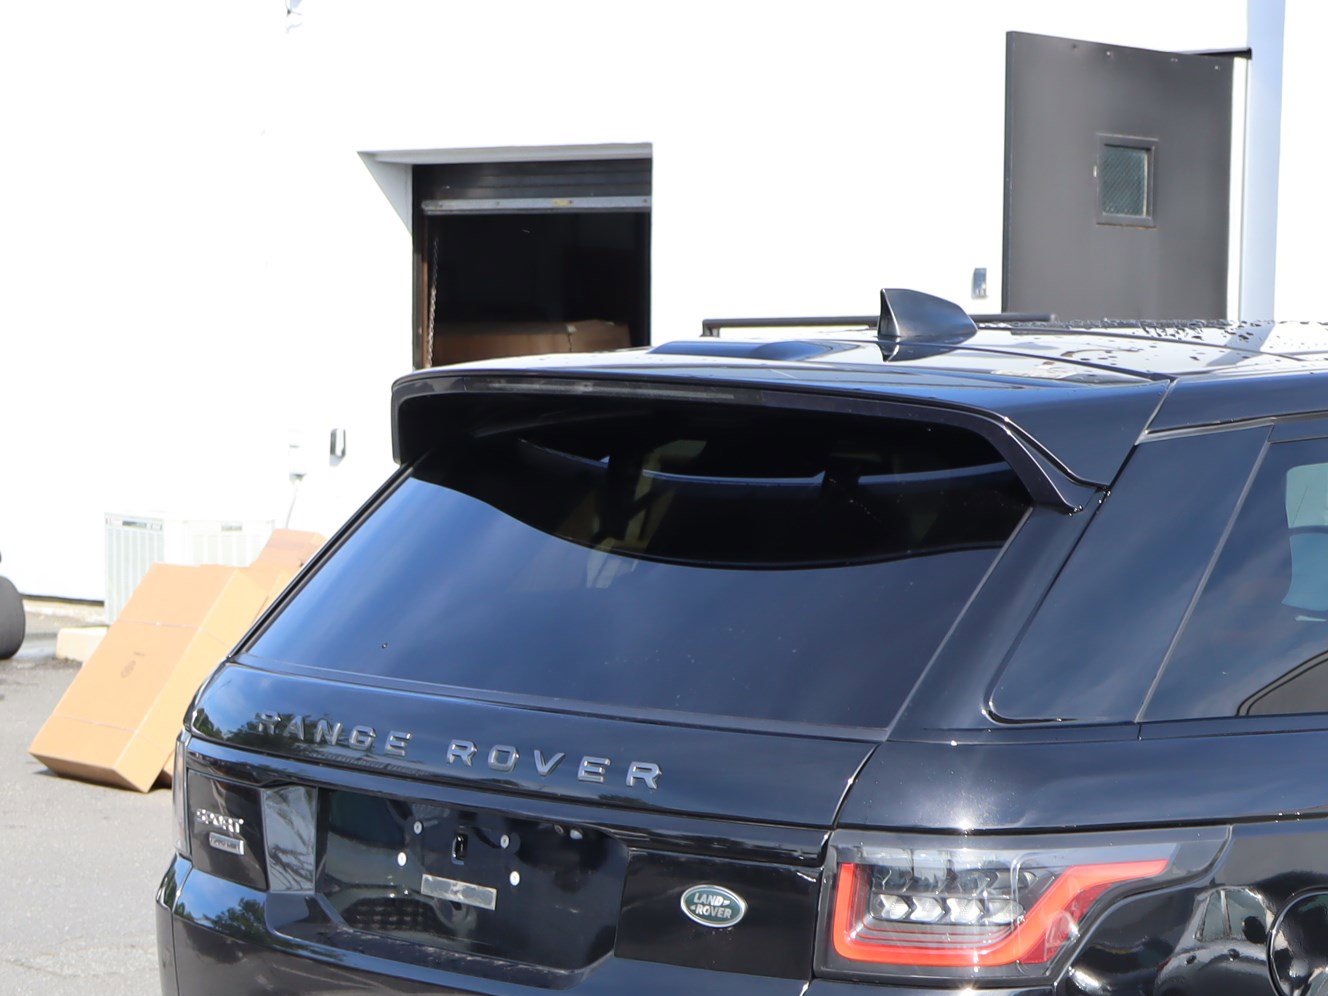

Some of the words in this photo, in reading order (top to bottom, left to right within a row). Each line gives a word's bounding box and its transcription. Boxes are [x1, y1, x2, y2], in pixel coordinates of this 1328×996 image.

[257, 710, 413, 758] RANGE
[446, 738, 663, 790] ROVER
[695, 903, 732, 919] ROVER
